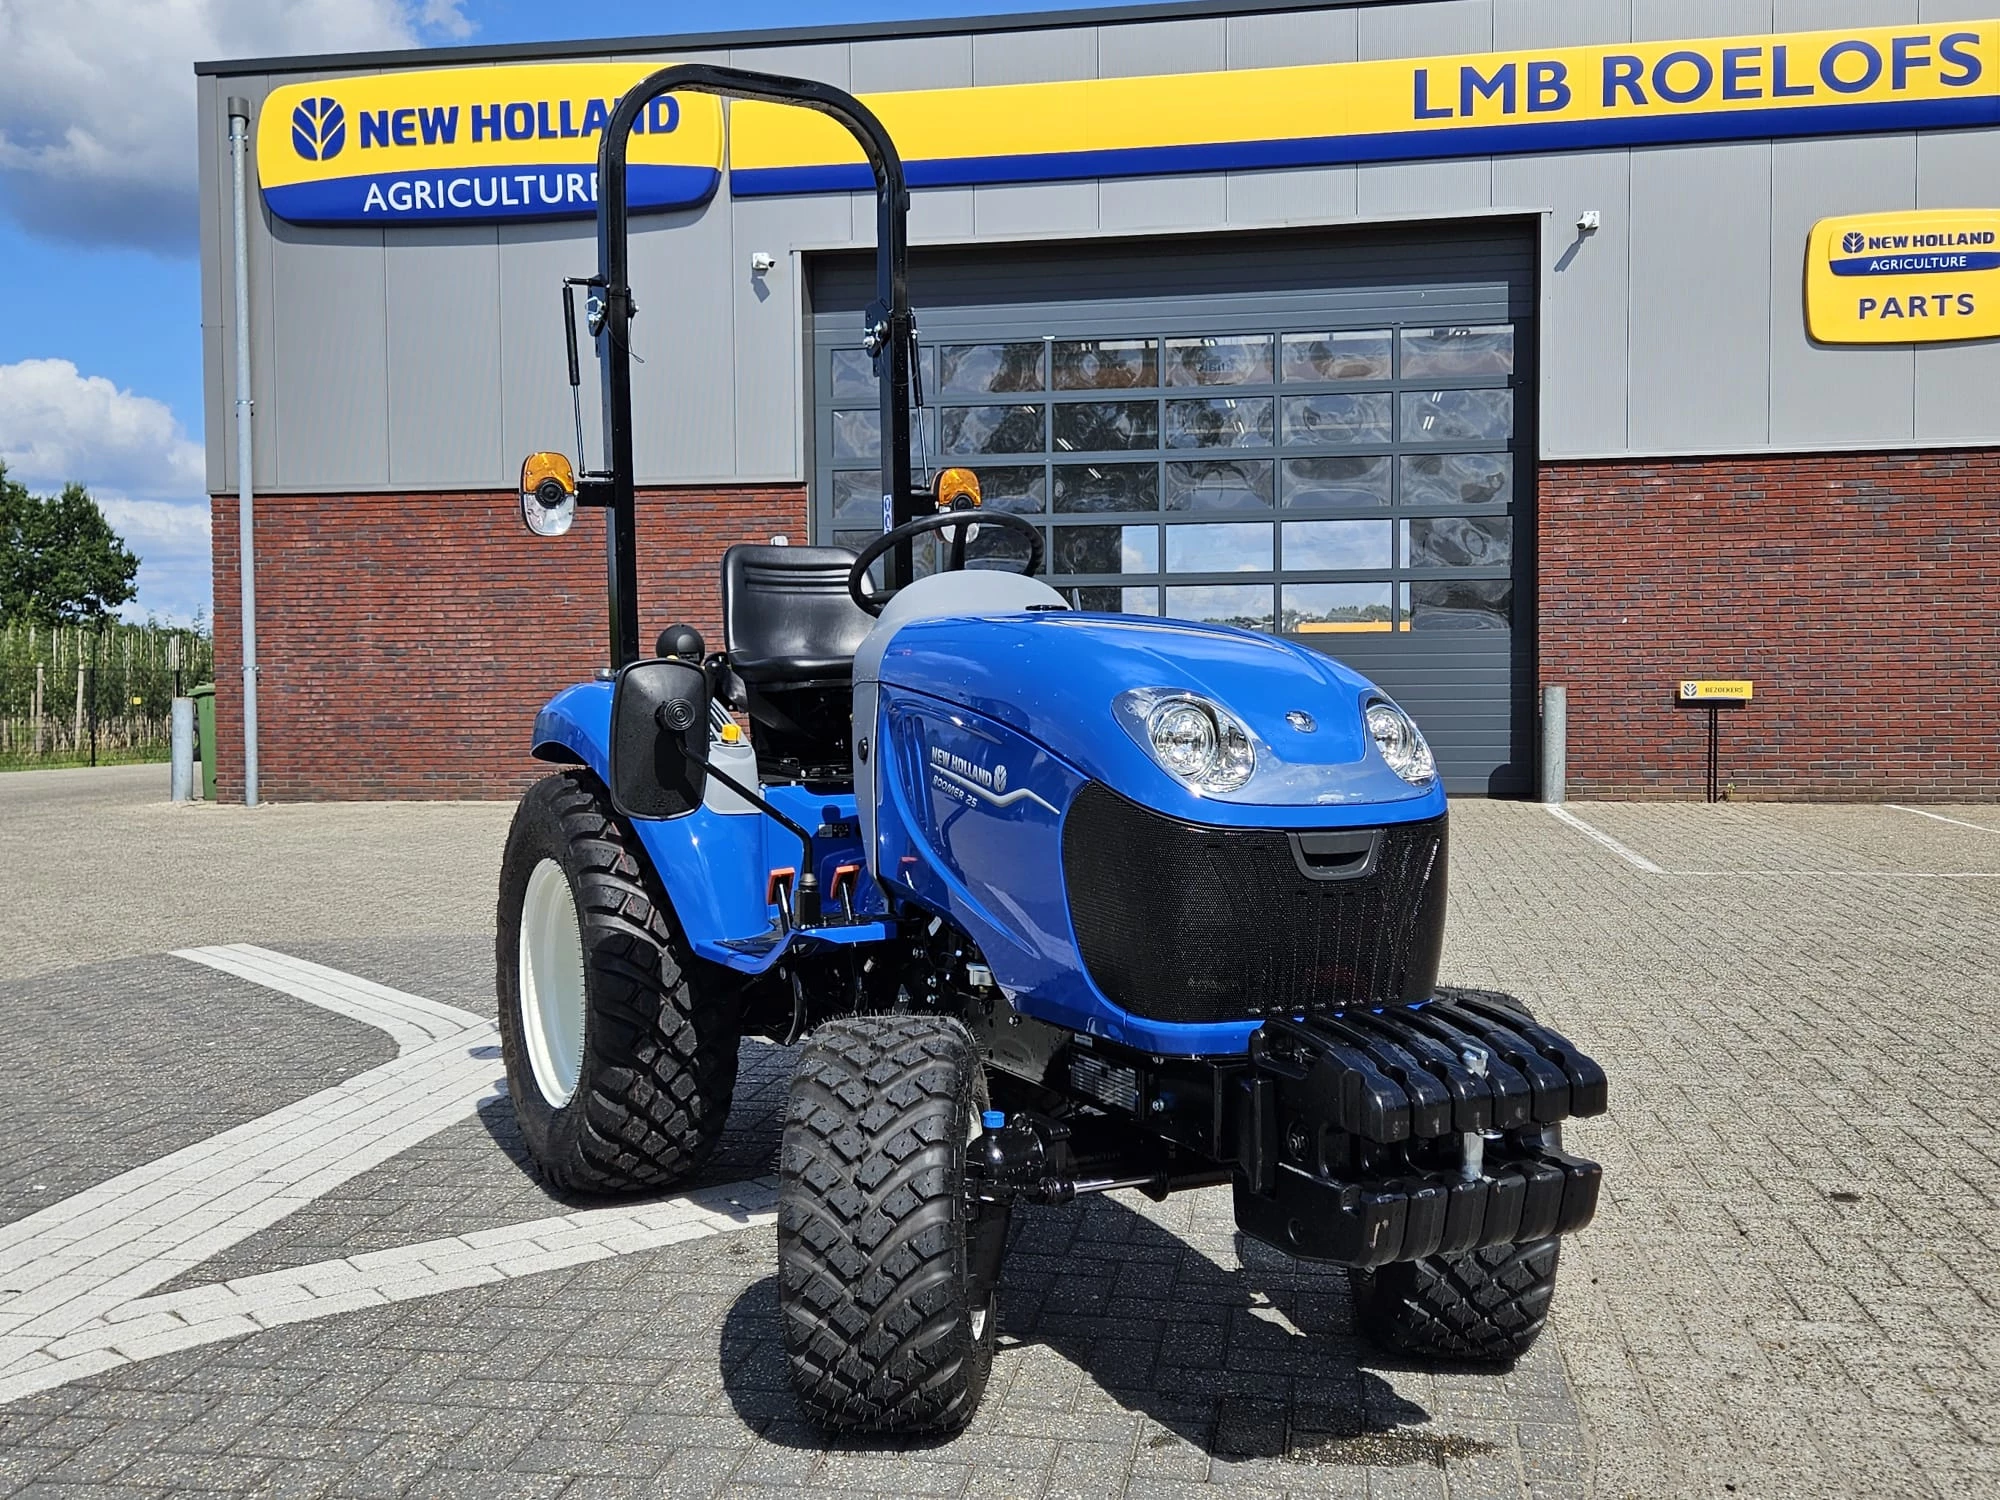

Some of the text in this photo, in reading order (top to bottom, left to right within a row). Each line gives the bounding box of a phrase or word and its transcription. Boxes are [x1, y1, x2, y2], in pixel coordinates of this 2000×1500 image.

[1414, 32, 1982, 119] LMB ROELOFS
[360, 106, 459, 149] NEW
[1869, 232, 1995, 249] NEW HOLLAND
[1869, 256, 1967, 271] AGRICULTURE
[1859, 293, 1974, 319] PARTS
[931, 746, 992, 787] NEW HOLLAND
[932, 775, 978, 808] BOOMER 25
